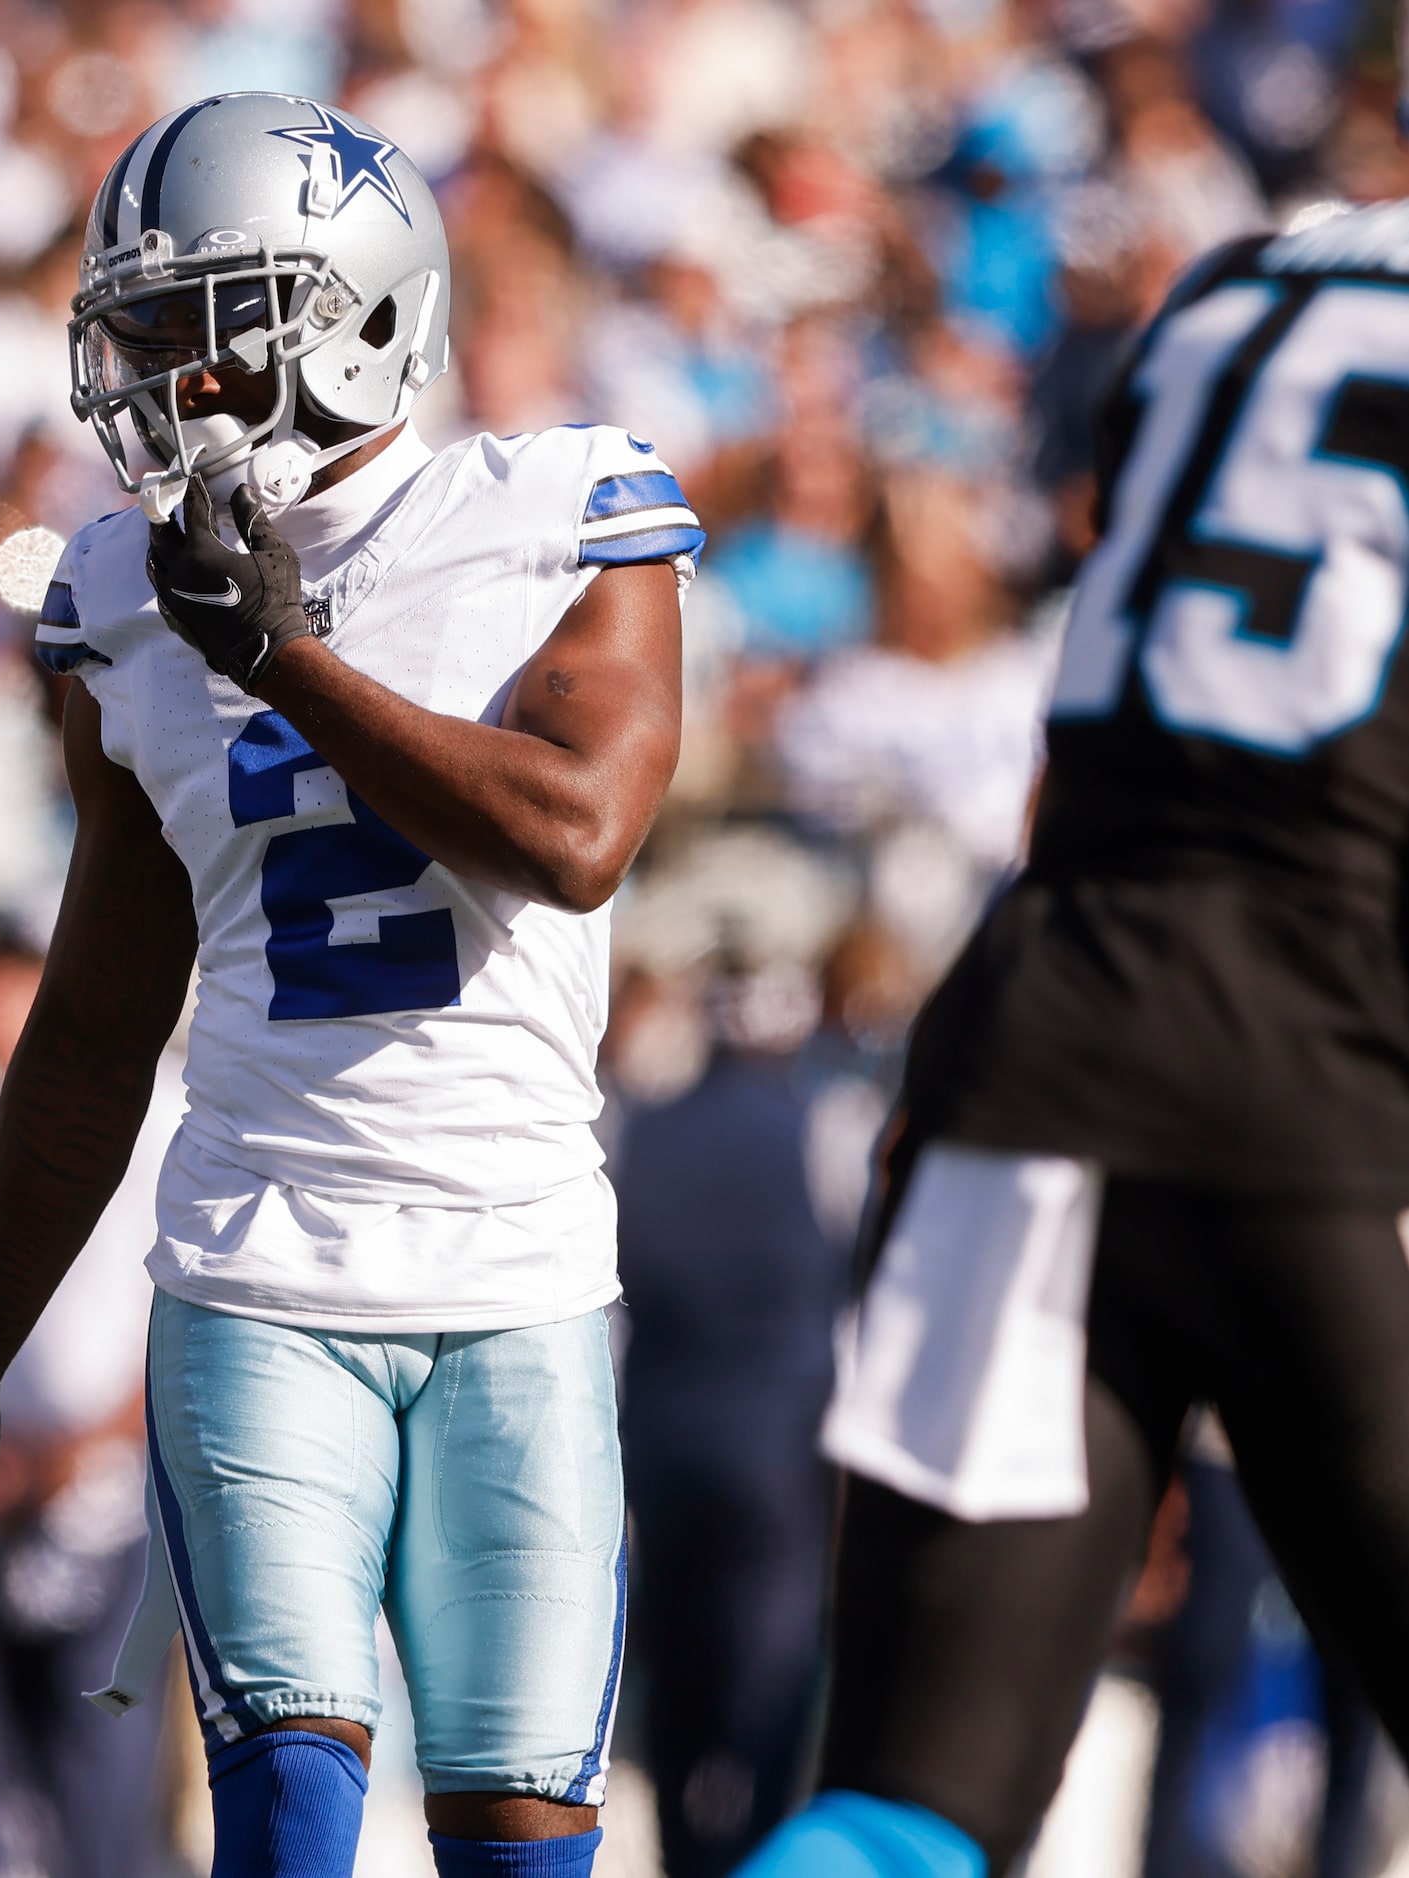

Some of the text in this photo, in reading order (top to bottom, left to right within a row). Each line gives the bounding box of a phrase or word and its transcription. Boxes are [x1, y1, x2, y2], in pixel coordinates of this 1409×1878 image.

[108, 247, 142, 268] COWBOY
[1047, 278, 1409, 760] 15
[228, 708, 462, 1022] 2
